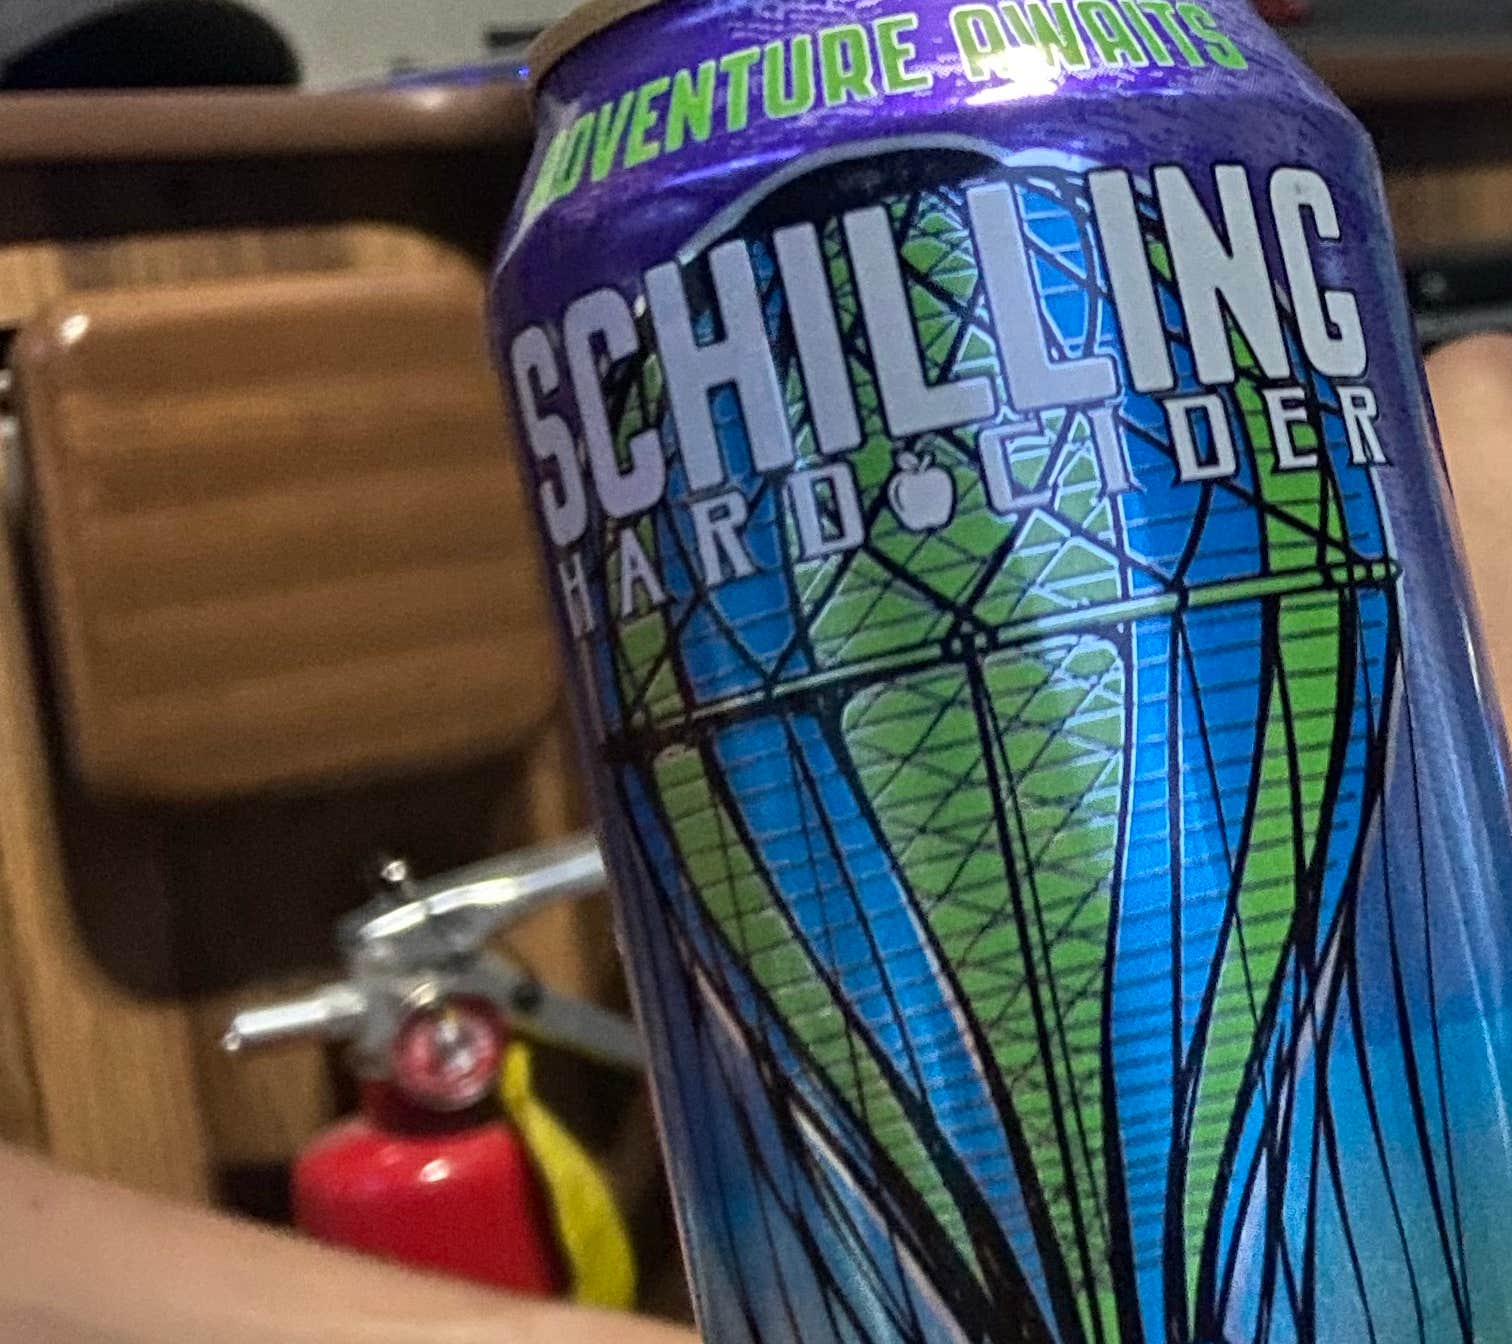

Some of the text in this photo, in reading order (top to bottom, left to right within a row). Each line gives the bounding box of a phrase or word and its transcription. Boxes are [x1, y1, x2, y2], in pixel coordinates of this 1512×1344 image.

[510, 163, 1368, 550] SCHILLING
[557, 384, 1391, 639] HARD CIDER
